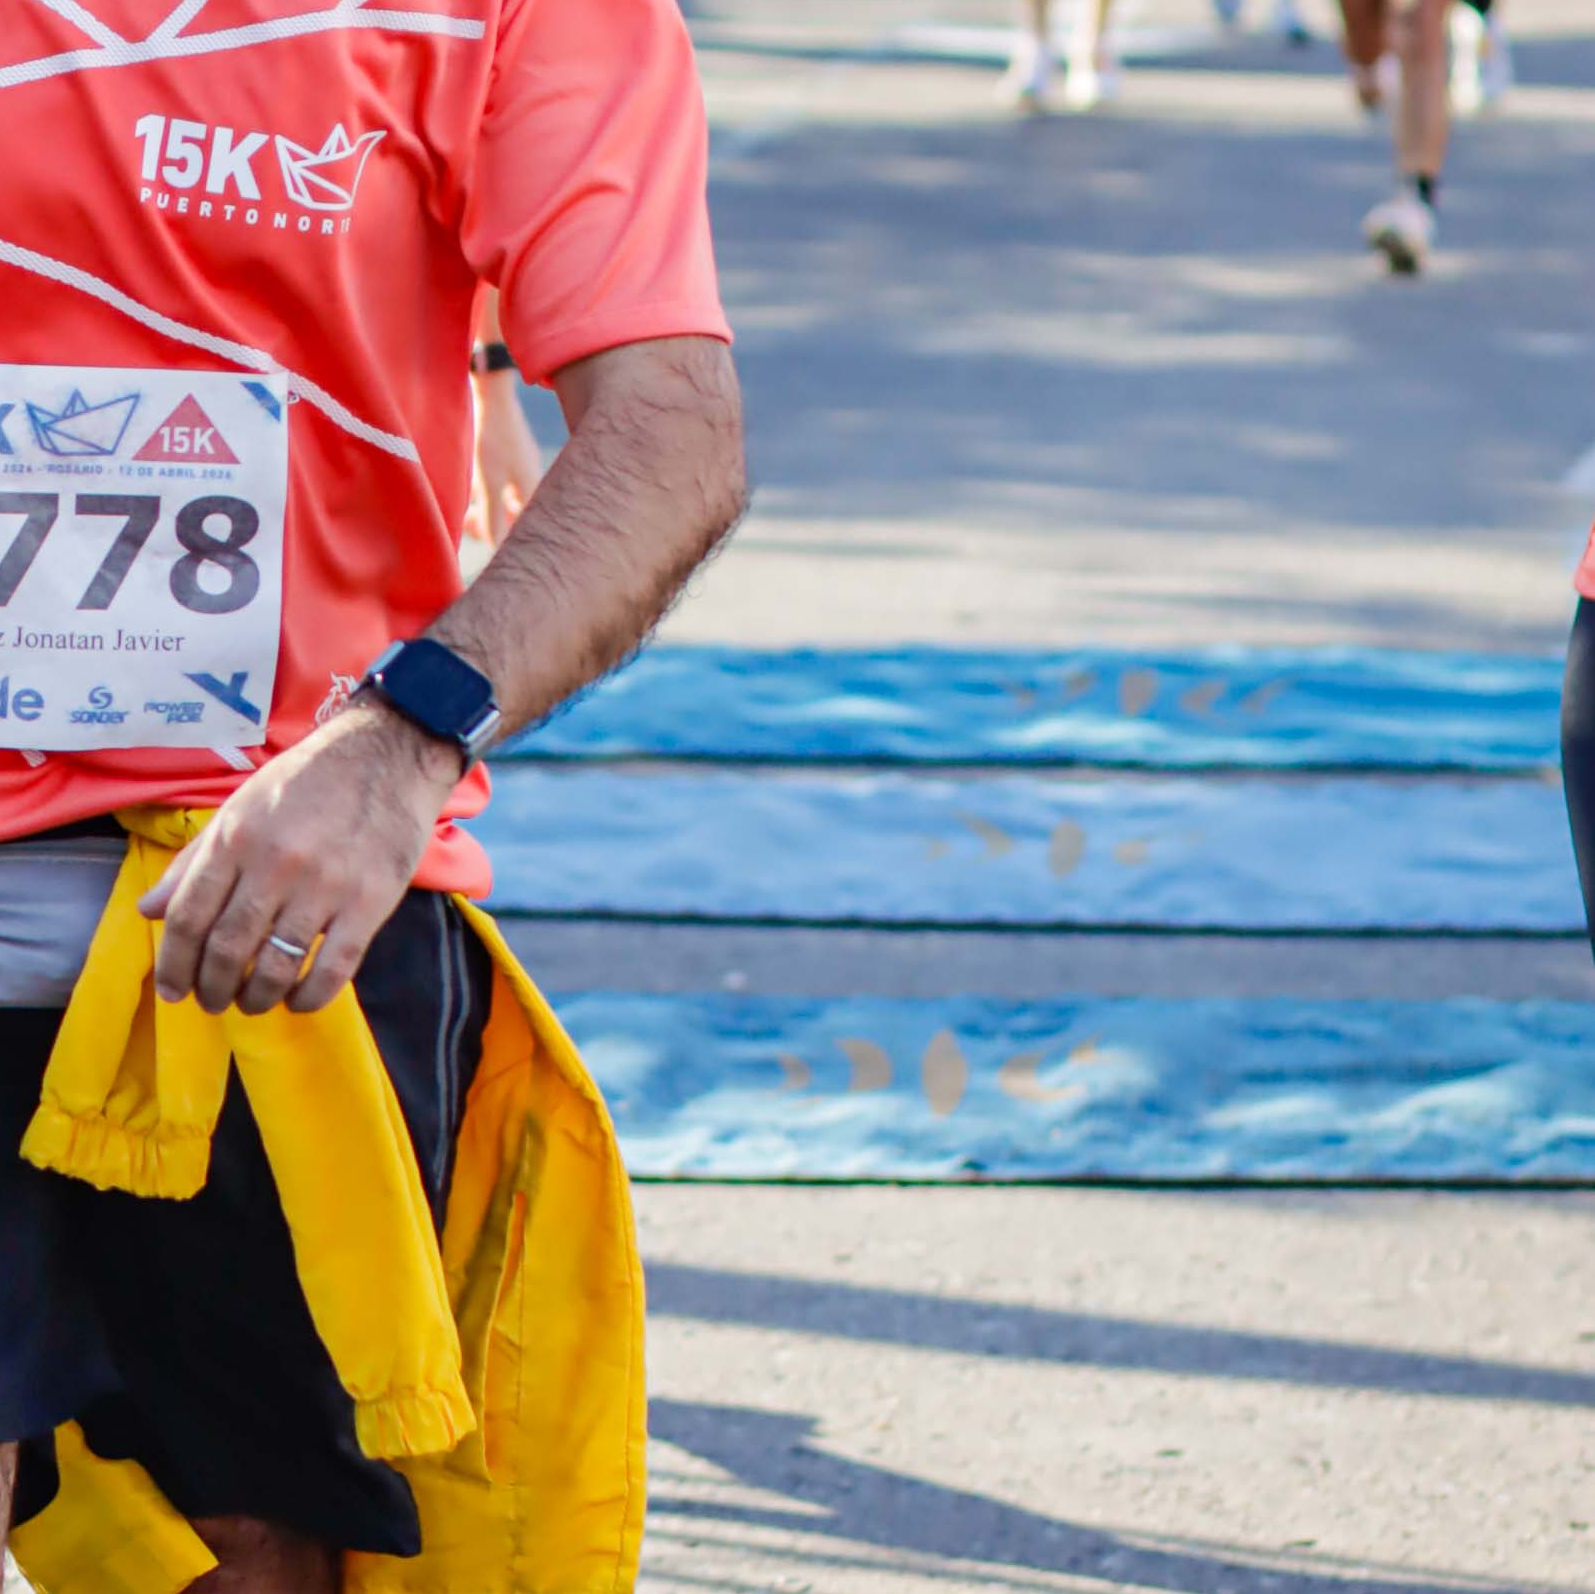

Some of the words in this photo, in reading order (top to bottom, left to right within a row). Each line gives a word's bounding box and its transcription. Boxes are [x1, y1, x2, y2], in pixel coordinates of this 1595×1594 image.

[134, 113, 270, 201] 15K
[139, 187, 260, 225] PUERTO
[158, 425, 215, 455] 15K
[12, 627, 104, 651] Jonatan
[112, 630, 186, 653] Javier
